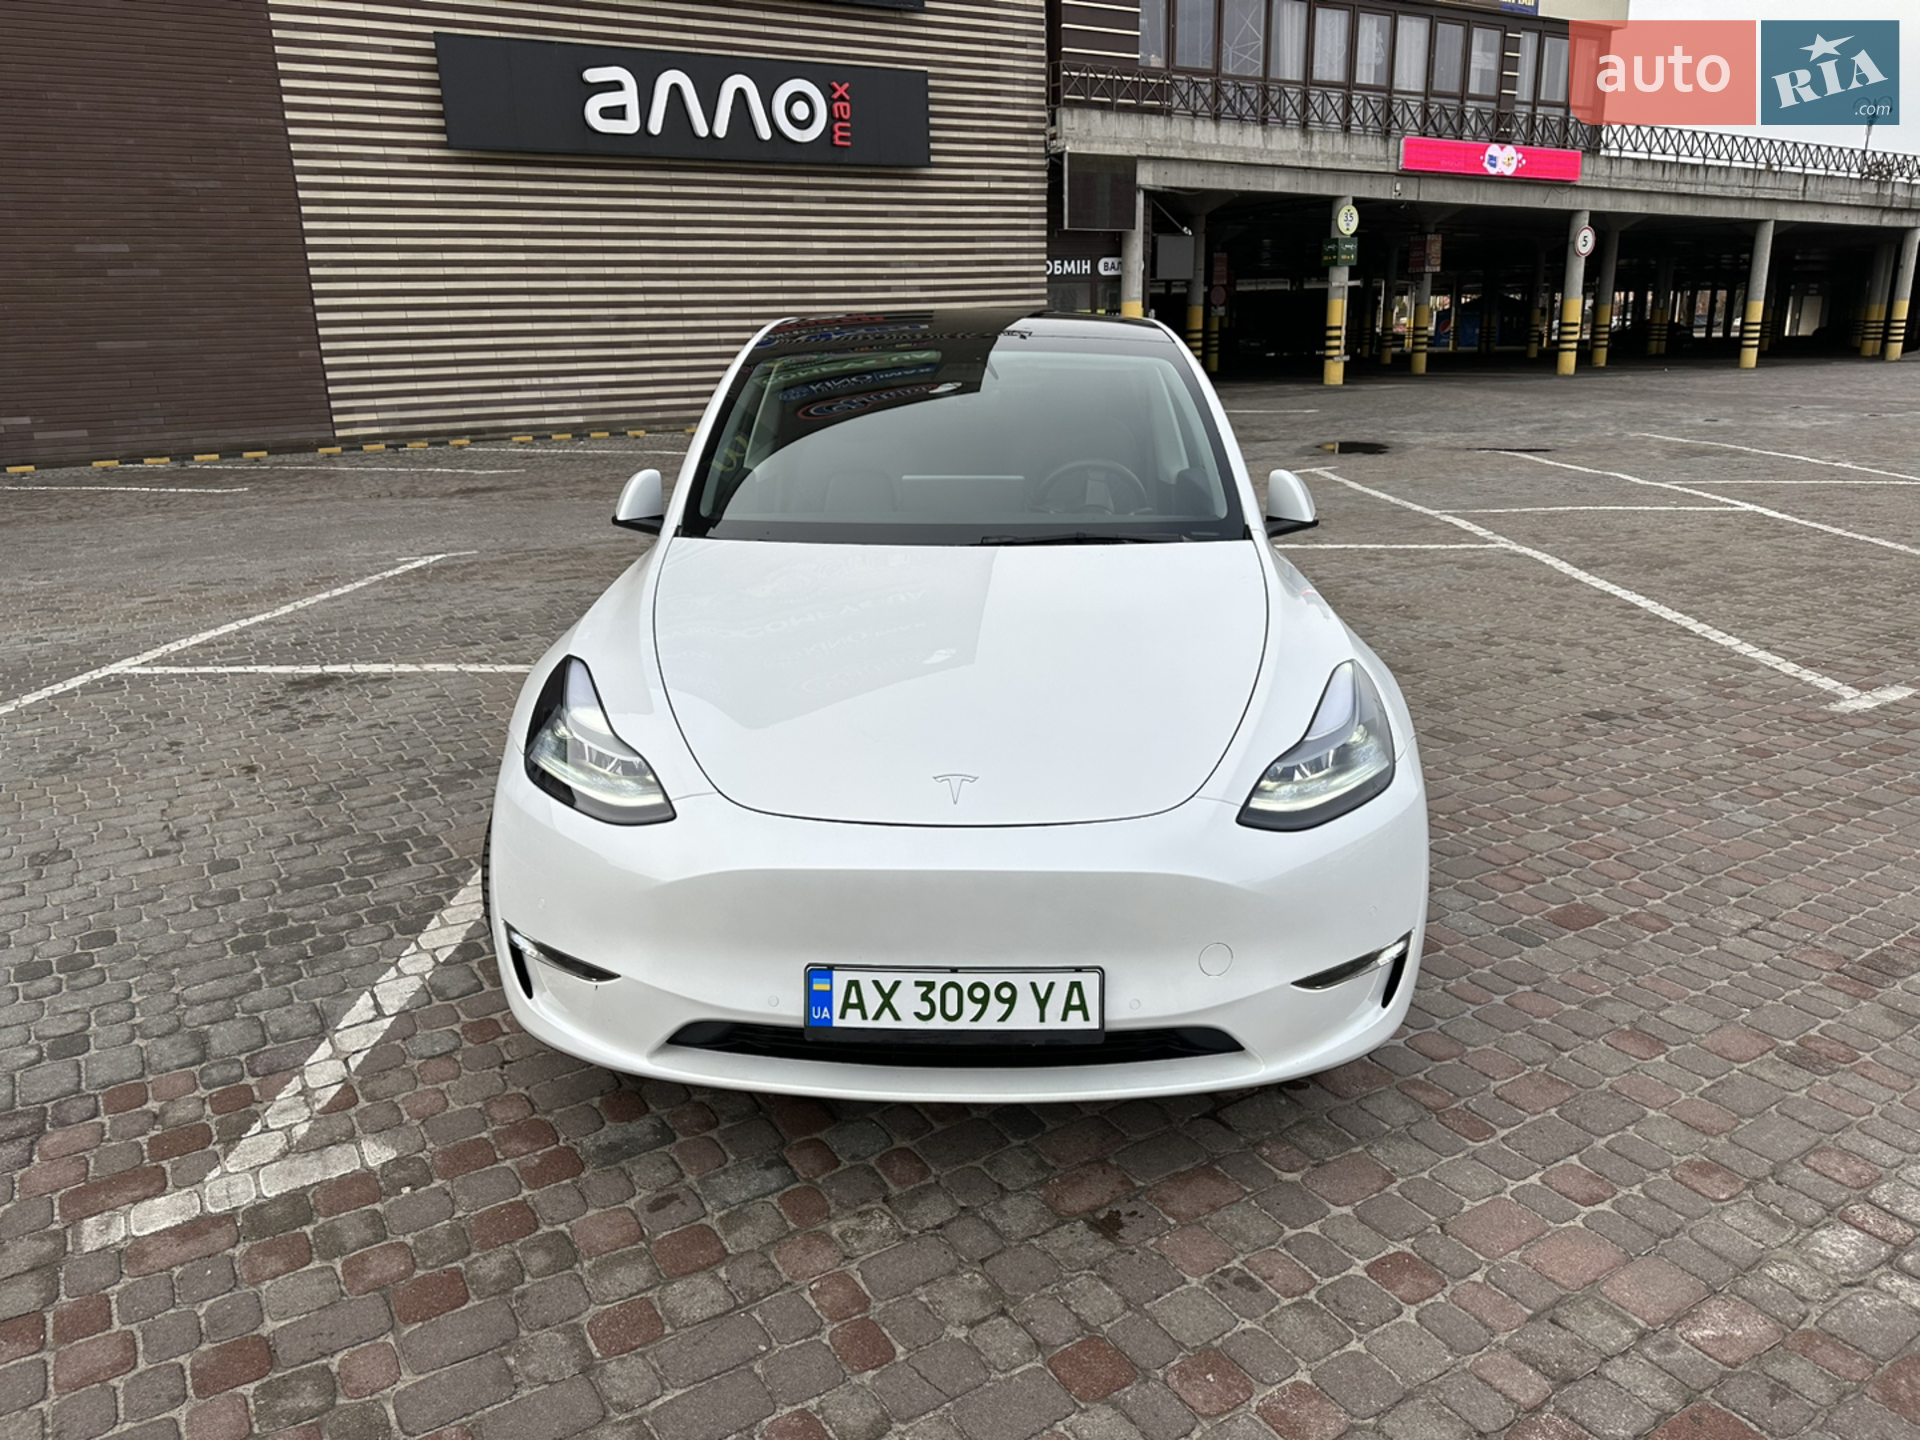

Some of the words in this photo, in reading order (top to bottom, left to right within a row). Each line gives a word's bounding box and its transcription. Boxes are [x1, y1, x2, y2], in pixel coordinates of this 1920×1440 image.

[831, 81, 851, 147] max
[811, 1006, 831, 1021] UA
[839, 979, 902, 1022] AX
[913, 980, 1018, 1023] 3099
[1029, 981, 1091, 1023] YA
